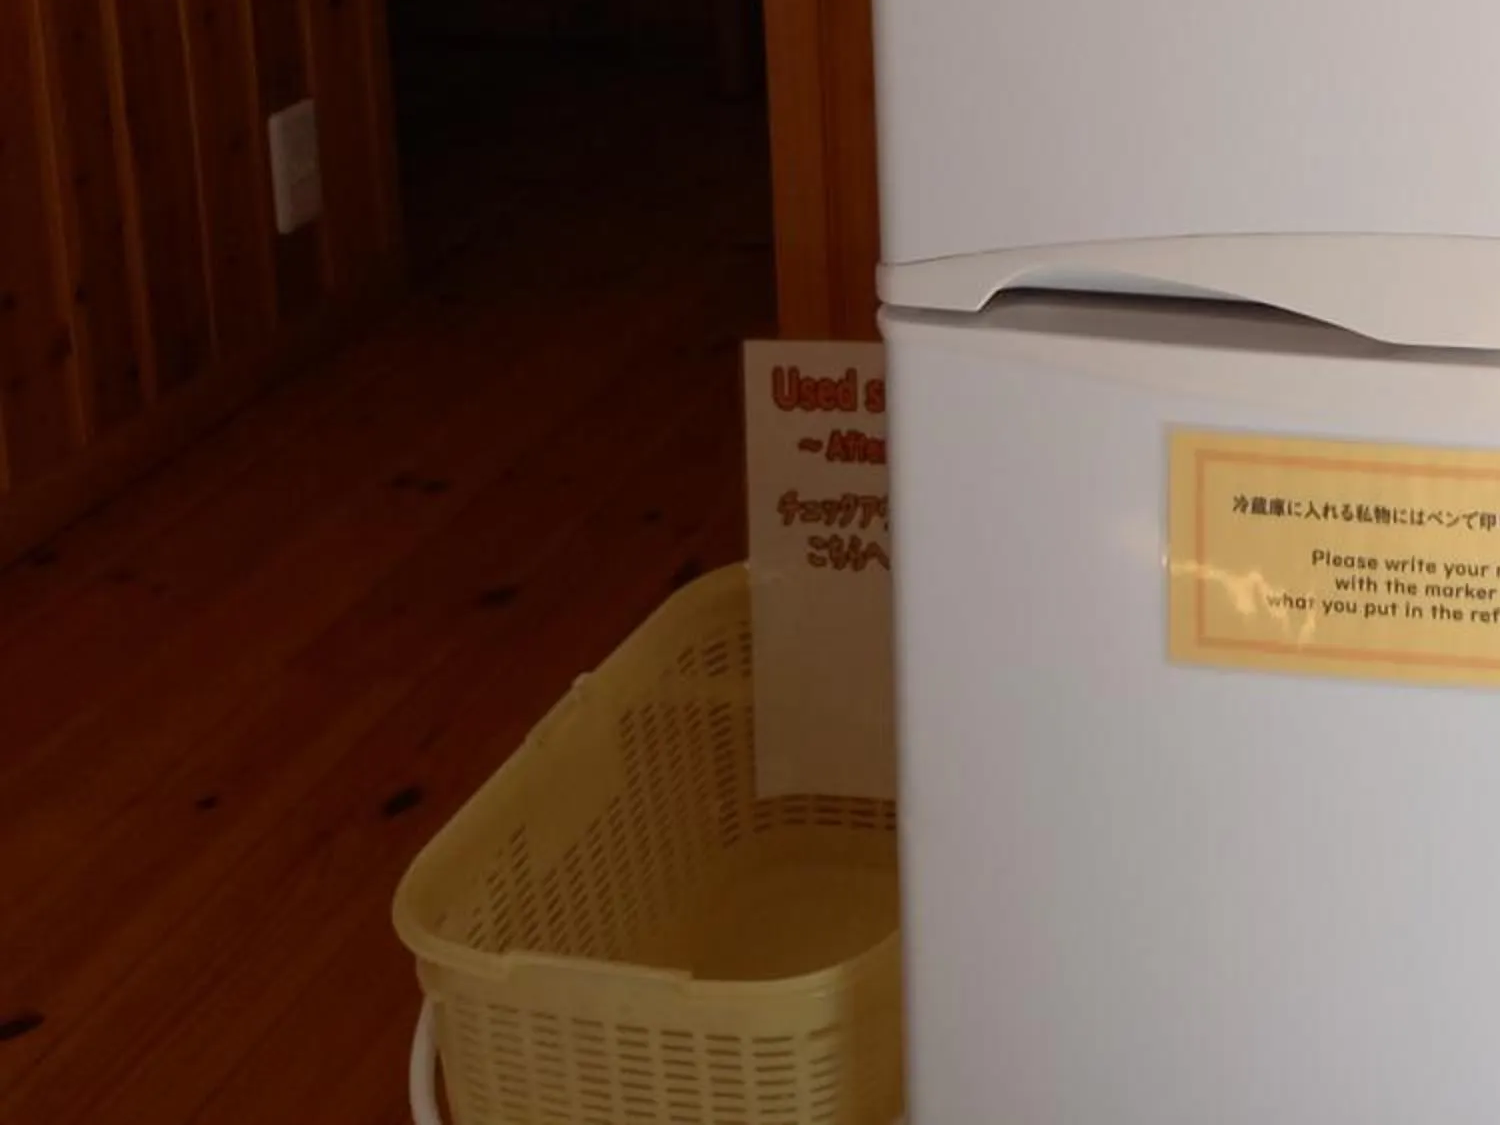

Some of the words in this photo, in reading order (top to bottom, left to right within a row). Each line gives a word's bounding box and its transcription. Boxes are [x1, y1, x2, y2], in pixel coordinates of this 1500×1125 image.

[772, 365, 858, 412] Used
[1311, 548, 1378, 570] Please
[1384, 555, 1437, 574] write
[1443, 561, 1489, 579] your
[1335, 575, 1378, 594] with
[1385, 578, 1417, 596] the
[1425, 581, 1497, 600] marker
[1321, 600, 1357, 616] you
[1364, 600, 1398, 618] put
[1405, 601, 1423, 618] in
[1431, 603, 1464, 621] the
